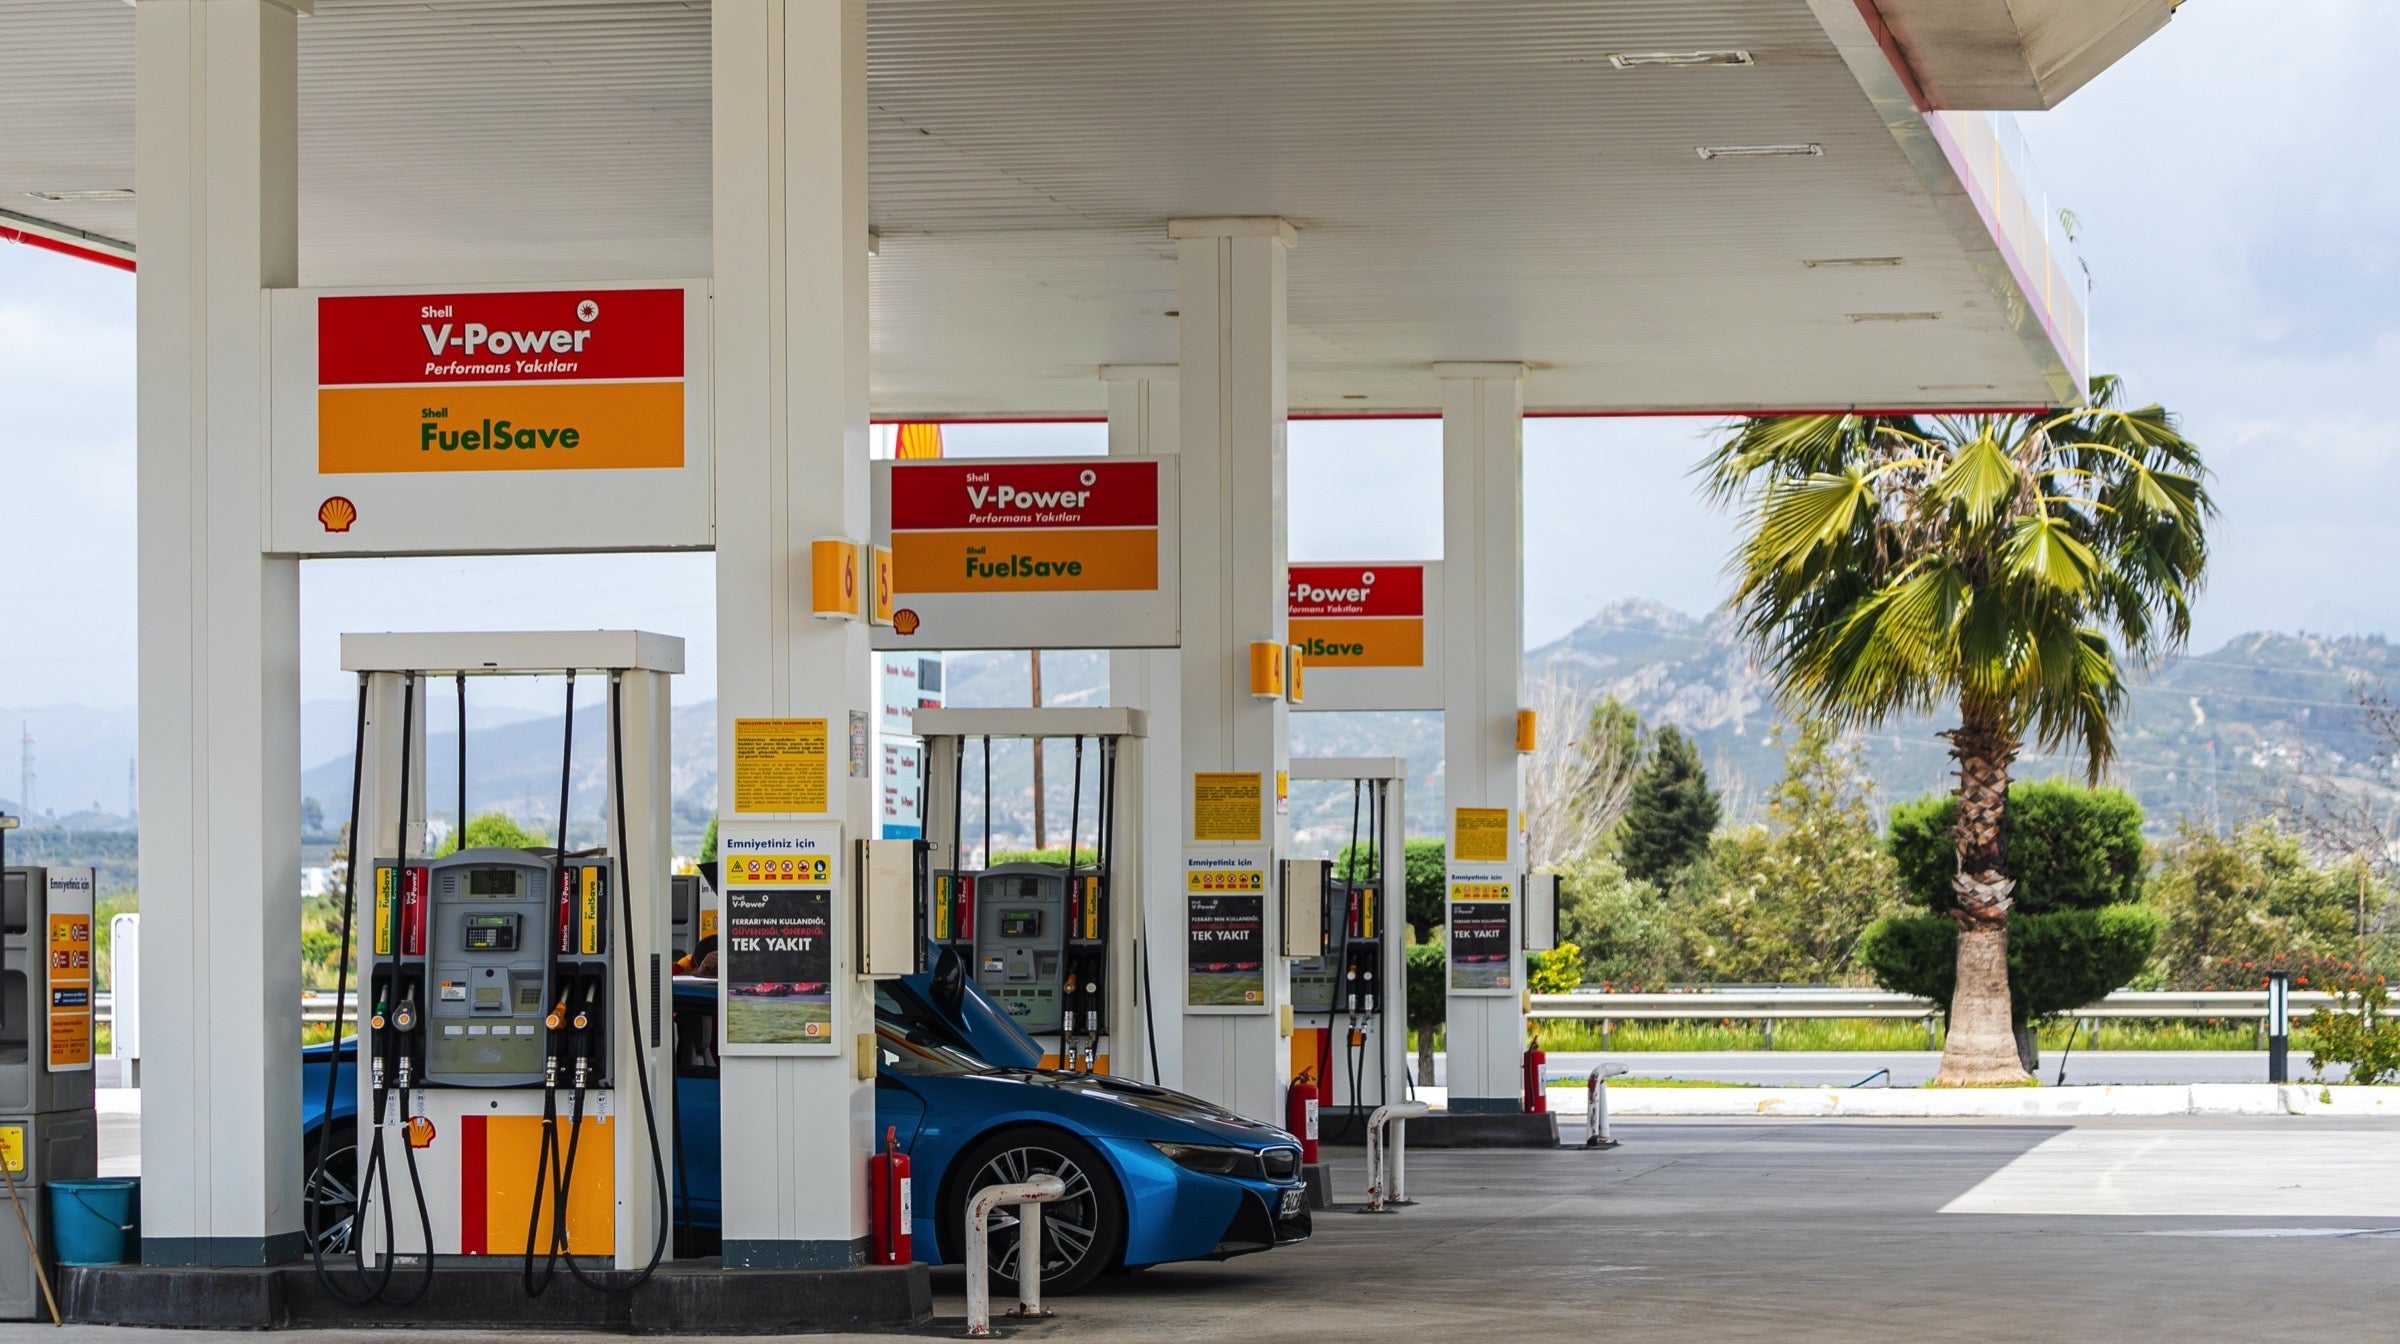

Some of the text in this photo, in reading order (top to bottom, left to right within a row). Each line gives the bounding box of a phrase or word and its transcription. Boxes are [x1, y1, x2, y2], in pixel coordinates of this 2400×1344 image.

[421, 305, 453, 319] Shell
[421, 322, 591, 356] V-Power
[425, 359, 578, 376] Performans Yakıtları
[421, 408, 448, 419] Shell
[421, 420, 580, 451] FuelSave
[966, 473, 989, 483] Shell
[966, 486, 1090, 509] V-Power
[969, 512, 1081, 524] Performans Yakıtları
[966, 547, 986, 555] Shell
[966, 555, 1082, 578] FuelSave
[845, 554, 853, 599] 6
[881, 563, 888, 606] 5
[1288, 583, 1370, 603] -Power
[1274, 652, 1280, 684] 4
[727, 839, 815, 850] Emniyetiniz için
[1188, 859, 1252, 867] Emniyetiniz için
[50, 877, 80, 892] Emniyetiniz
[561, 872, 569, 904] V-Power
[588, 881, 596, 920] FuelSave
[1191, 930, 1250, 941] TEK YAKIT
[1454, 930, 1500, 938] TEK YAKIT
[732, 938, 812, 951] TEK YAKIT
